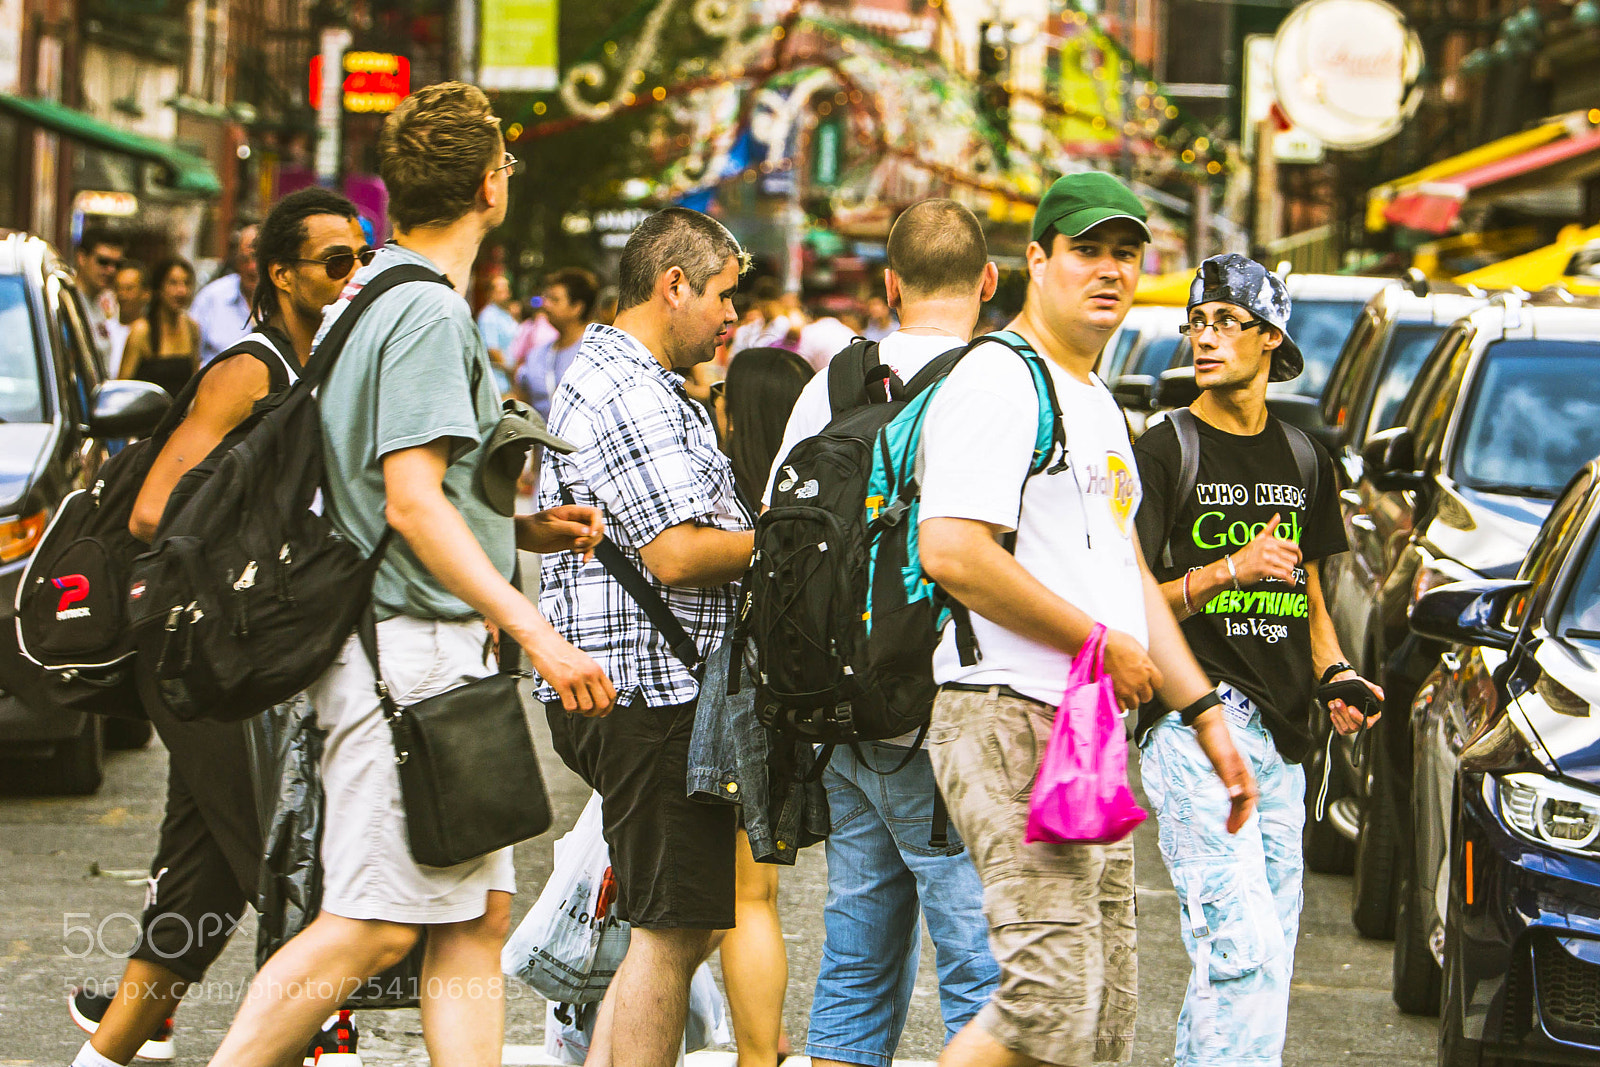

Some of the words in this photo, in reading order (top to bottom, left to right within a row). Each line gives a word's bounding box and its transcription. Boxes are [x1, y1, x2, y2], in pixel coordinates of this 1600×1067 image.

[1196, 483, 1249, 506] WHO
[1200, 590, 1308, 618] VERYTHING!
[1247, 617, 1288, 644] Vegas
